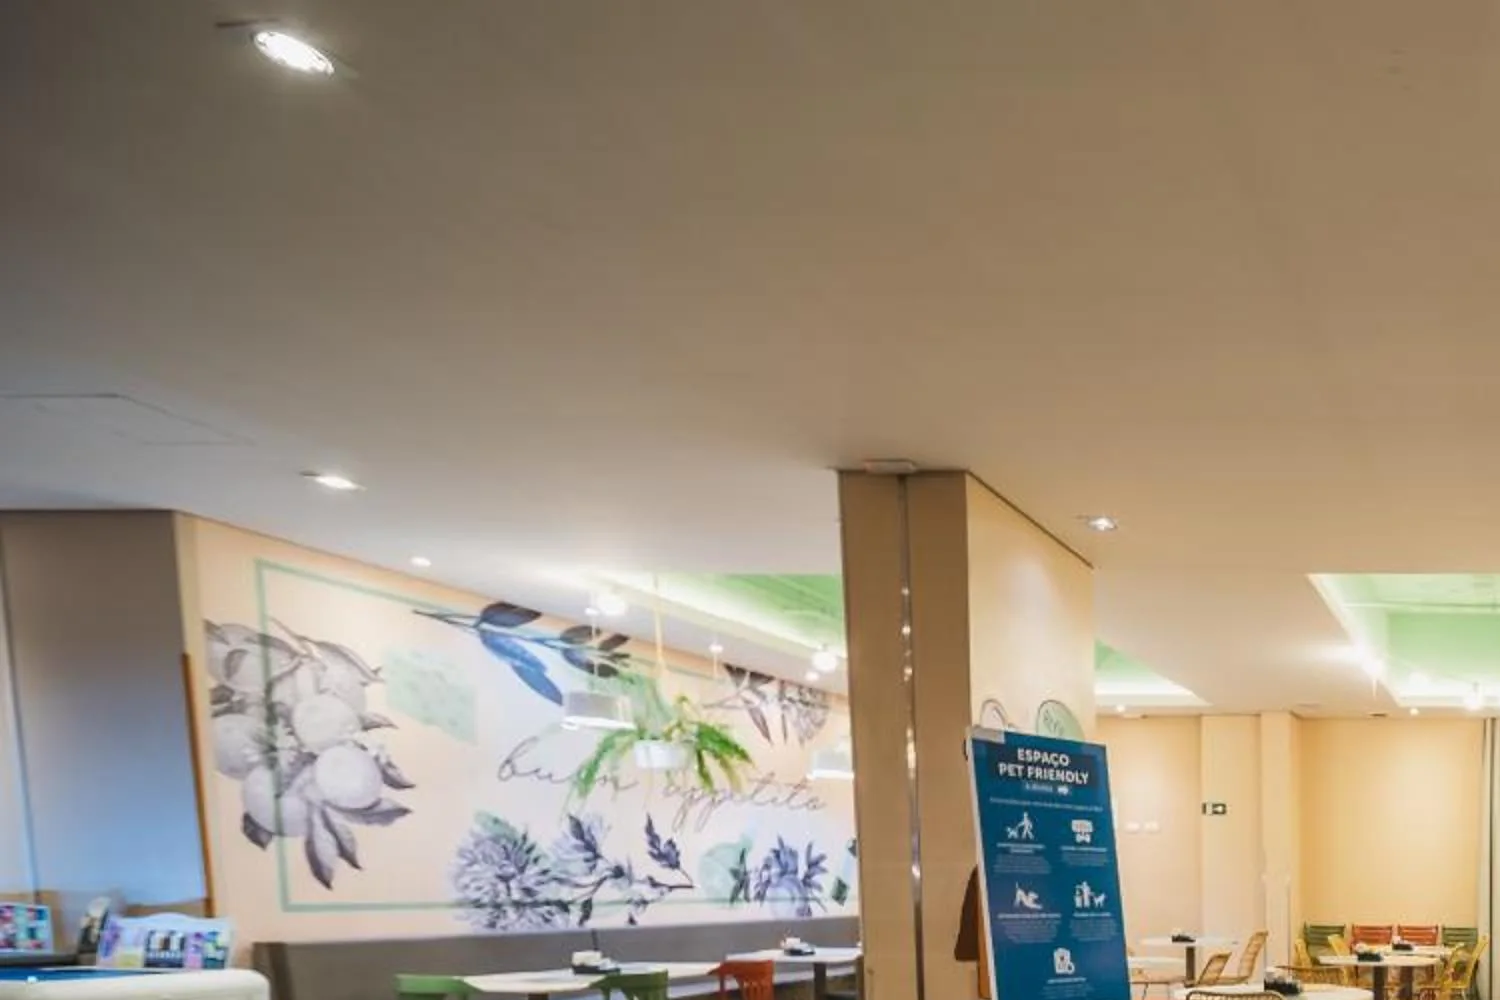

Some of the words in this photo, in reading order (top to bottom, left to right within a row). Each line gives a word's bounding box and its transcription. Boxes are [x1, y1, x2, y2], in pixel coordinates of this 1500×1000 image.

[1018, 748, 1069, 767] ESPAÇO
[999, 762, 1024, 777] PET
[1028, 766, 1088, 784] FRIENDLY
